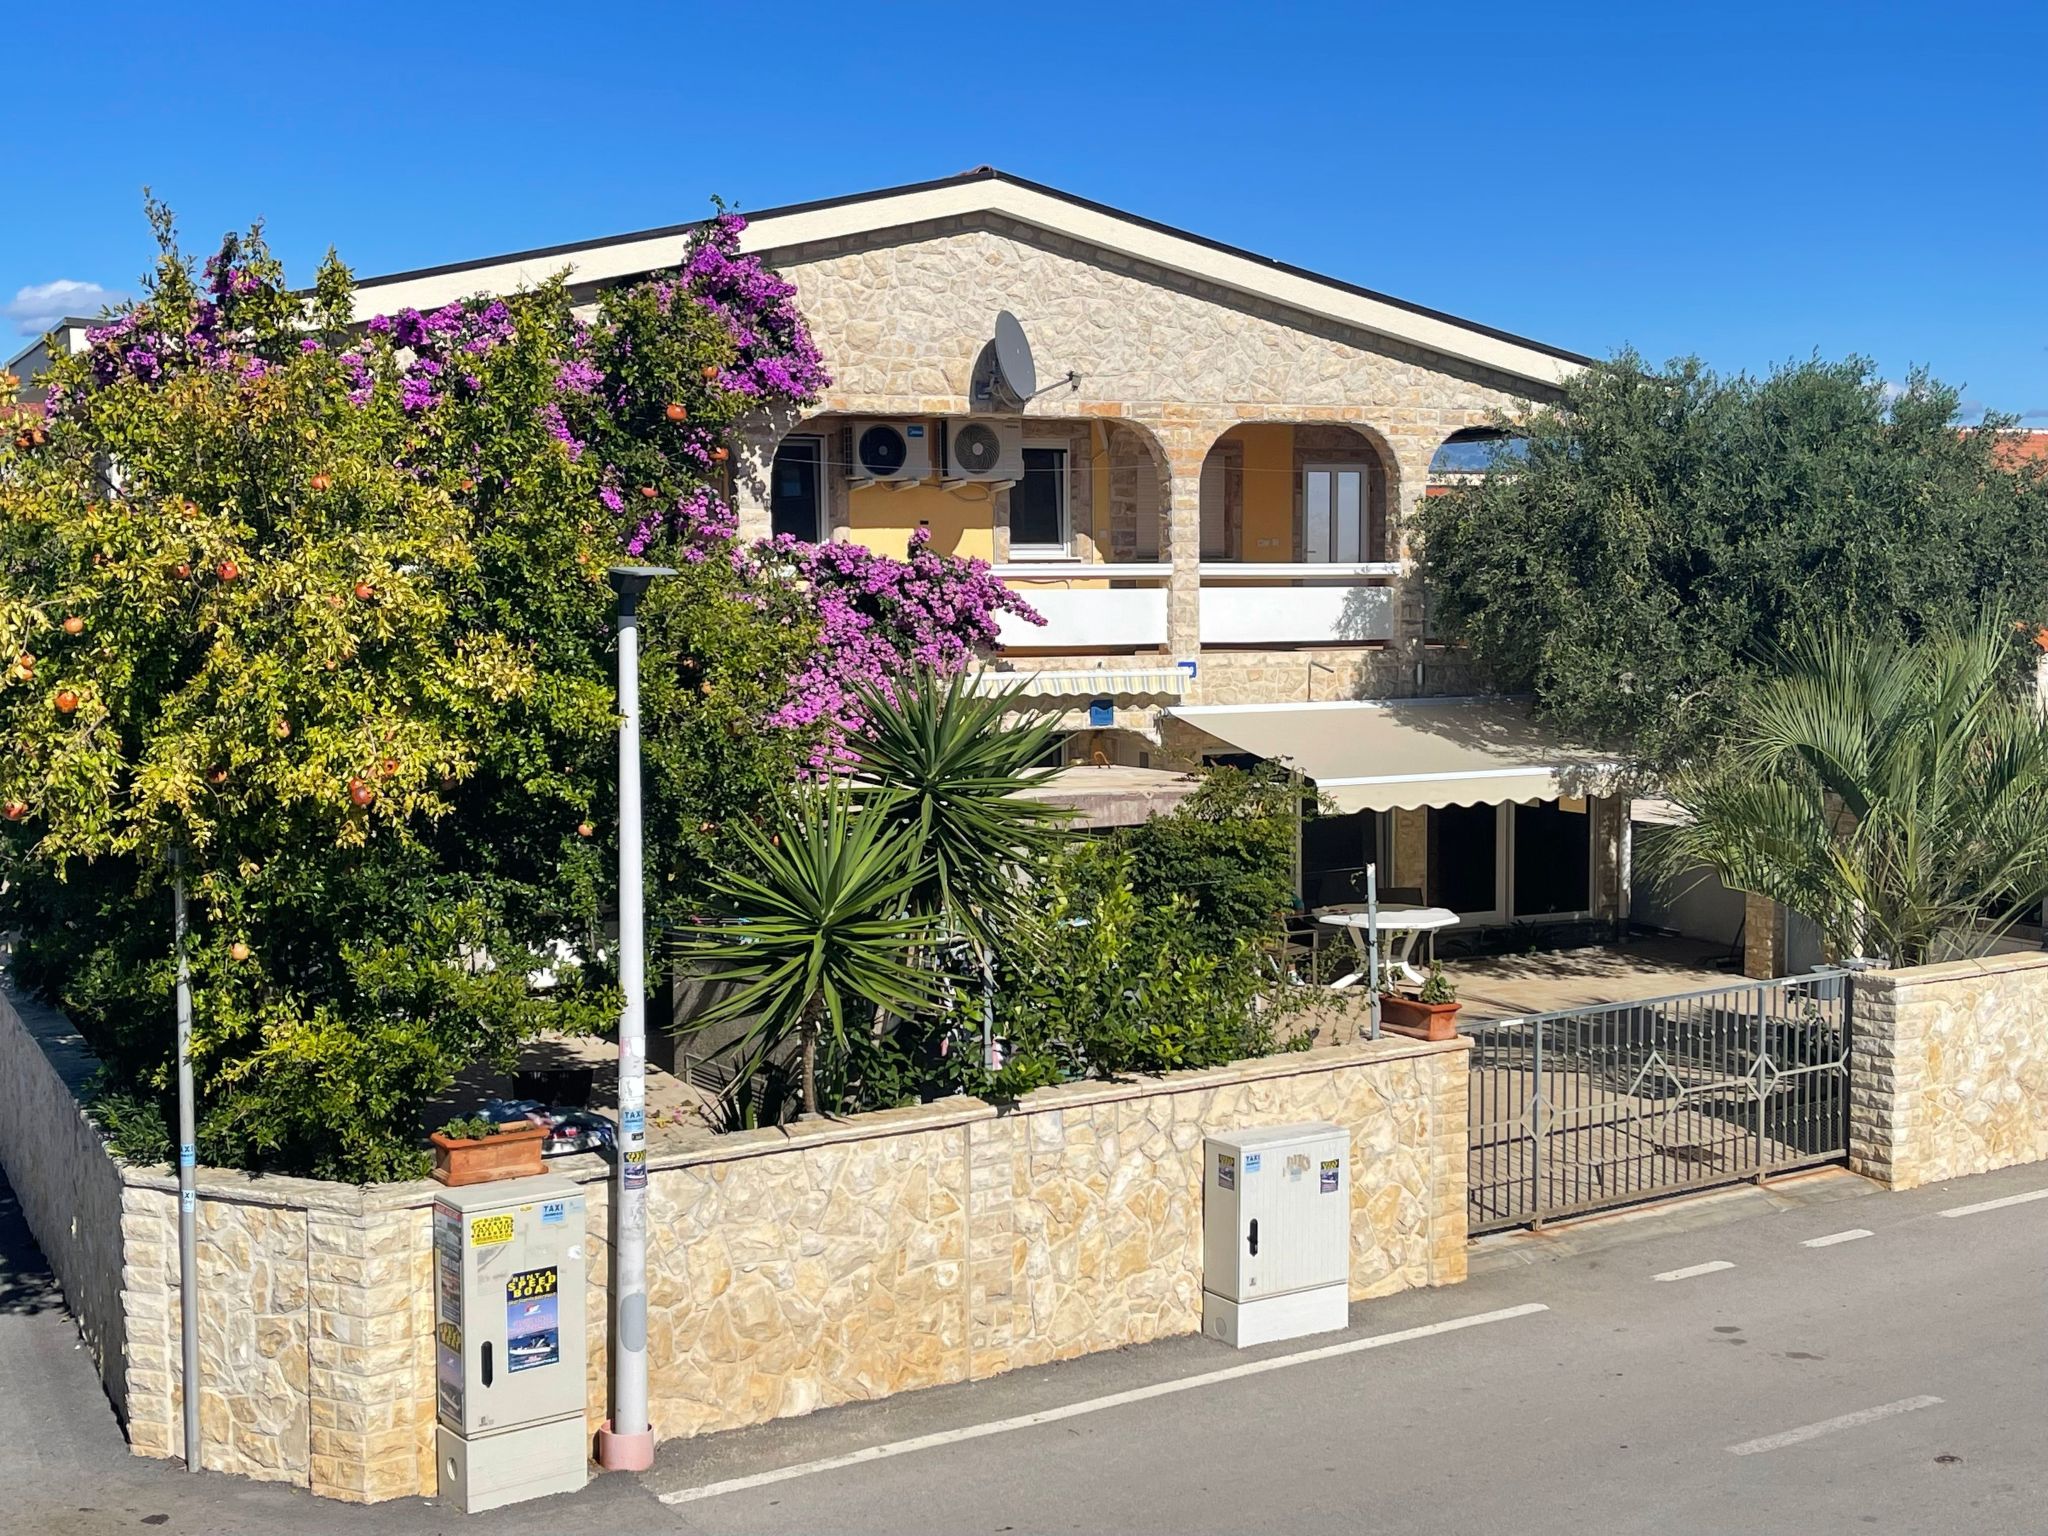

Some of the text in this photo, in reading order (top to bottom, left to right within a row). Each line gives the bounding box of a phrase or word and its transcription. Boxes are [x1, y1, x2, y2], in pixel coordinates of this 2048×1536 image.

[544, 1204, 563, 1212] TAXI
[472, 1225, 494, 1235] TAXI
[513, 1273, 540, 1282] RENT
[508, 1275, 556, 1291] SPEED
[513, 1284, 552, 1298] BOAT
